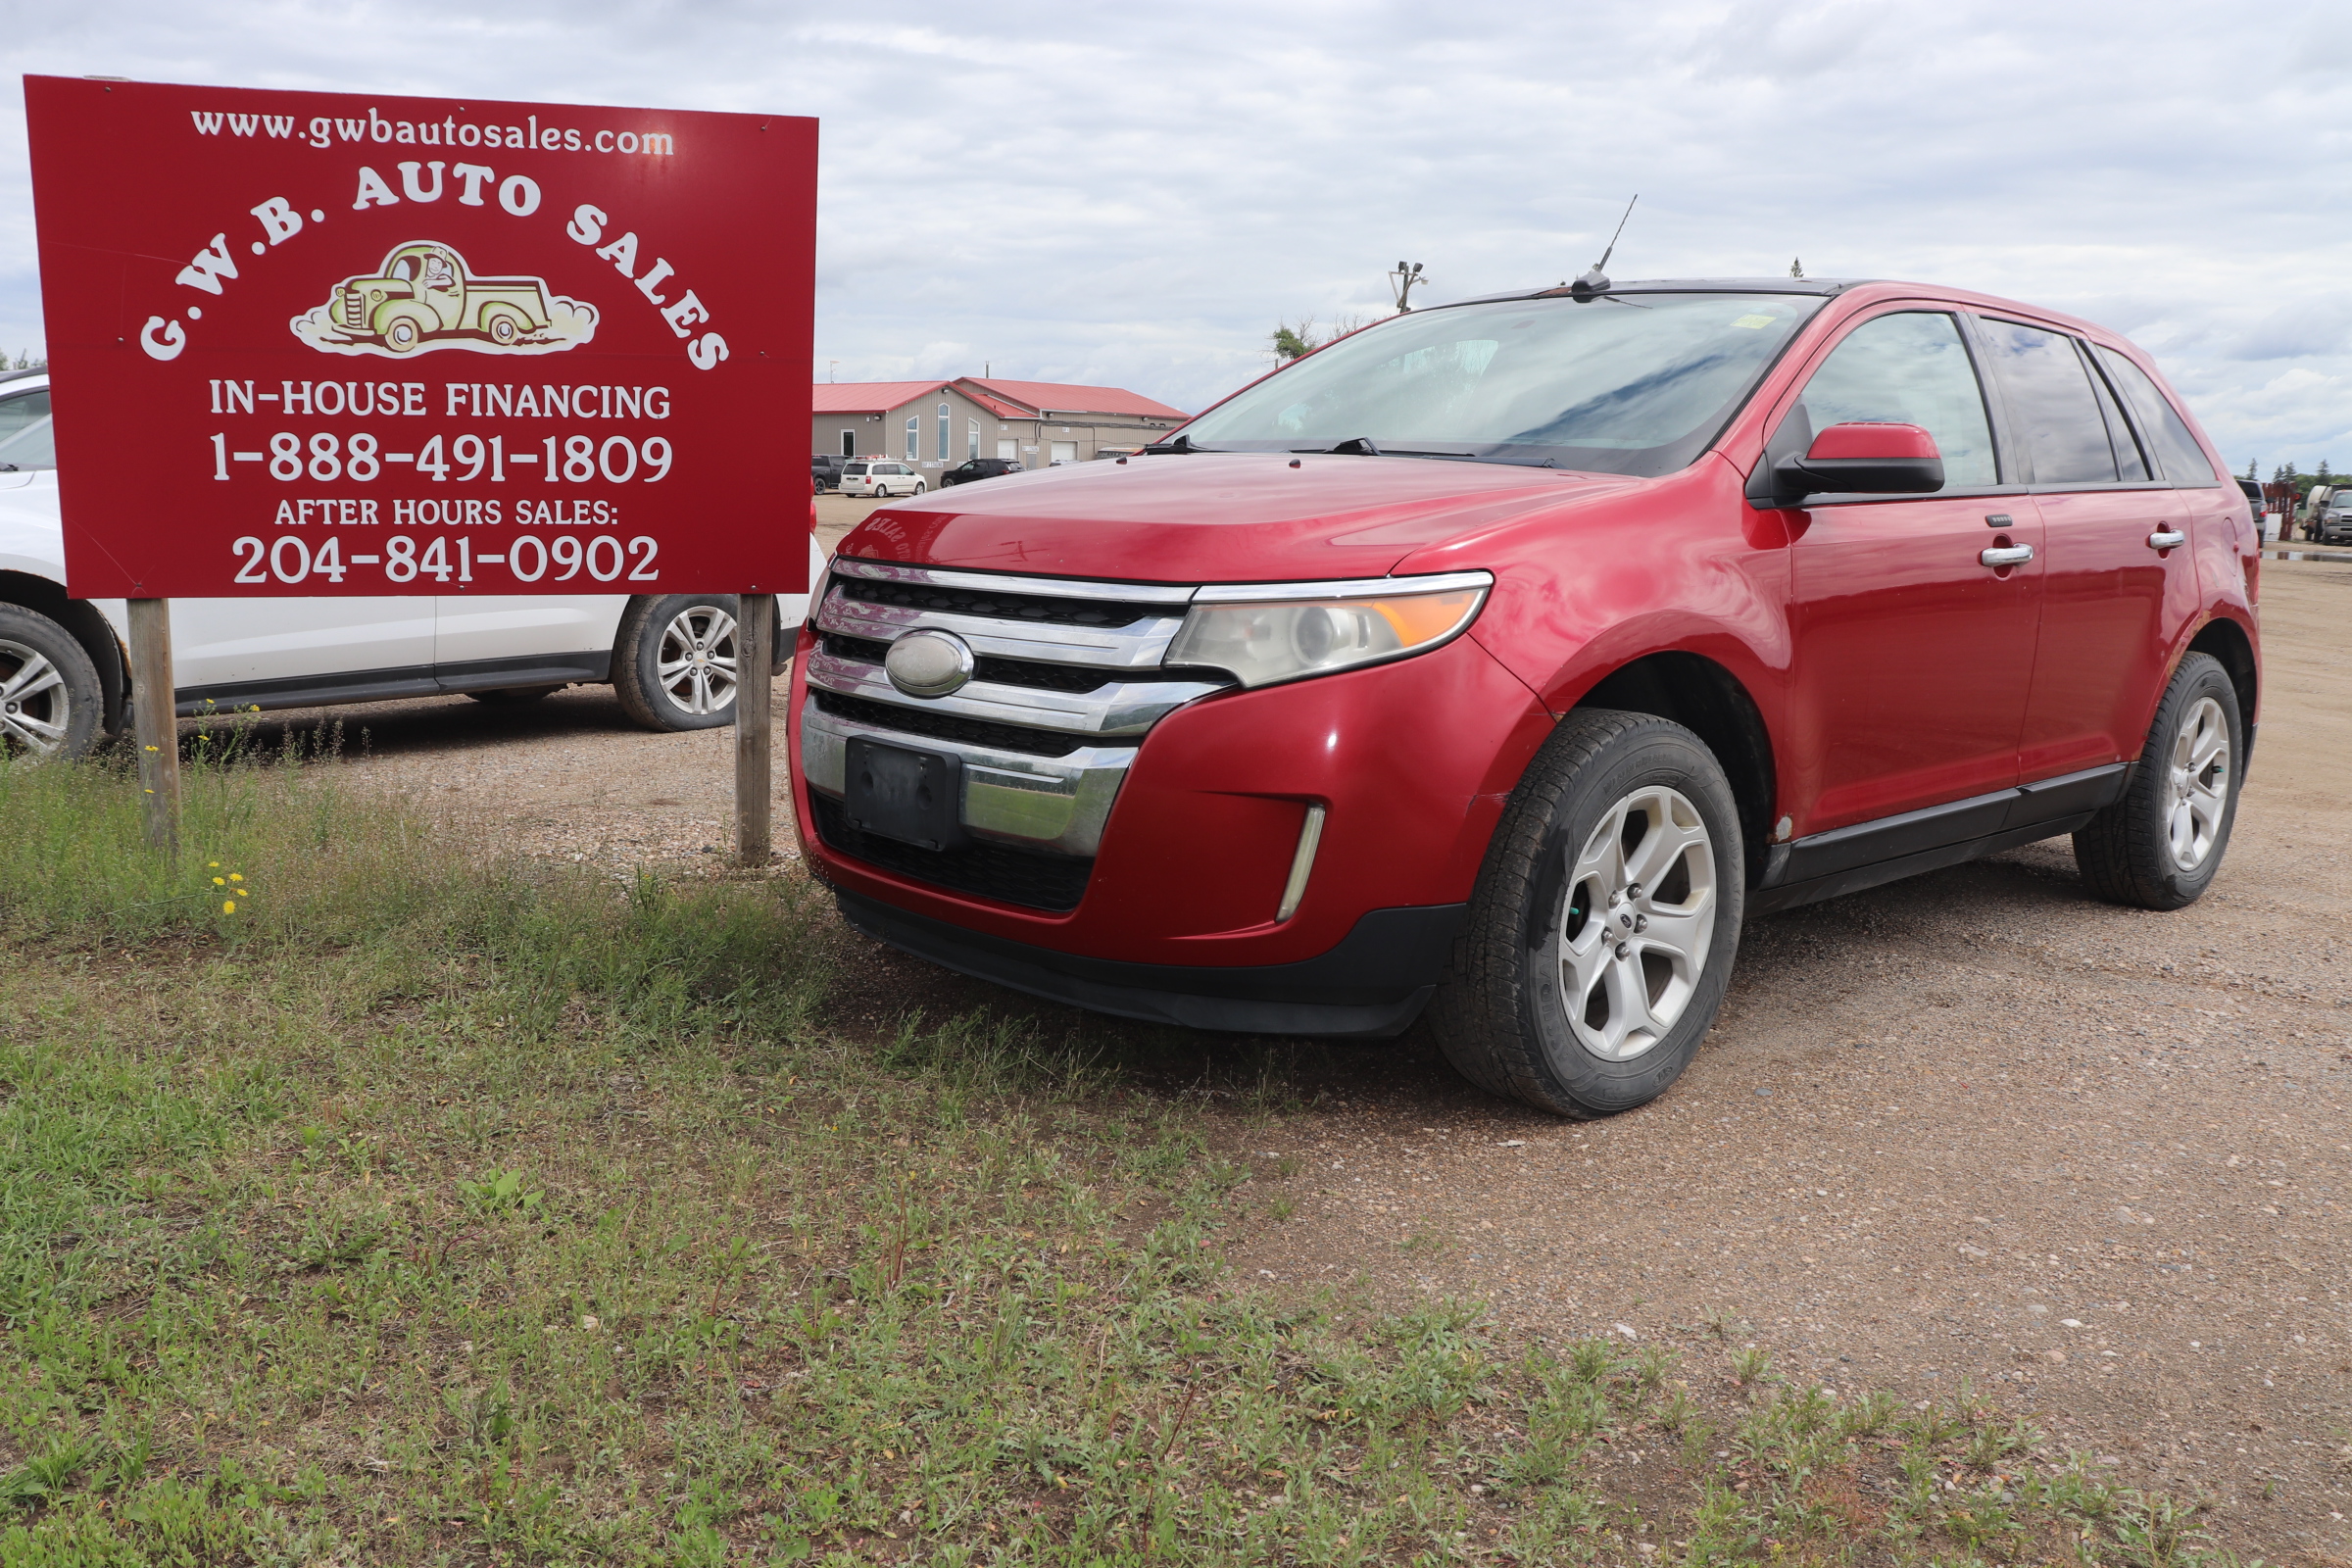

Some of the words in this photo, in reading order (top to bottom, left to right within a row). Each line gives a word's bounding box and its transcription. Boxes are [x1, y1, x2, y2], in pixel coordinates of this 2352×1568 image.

[190, 107, 675, 156] www.gwbautosales.com
[140, 196, 325, 362] G.W.B.
[352, 160, 542, 218] AUTO
[565, 203, 730, 370] SALES
[209, 379, 427, 416] IN-HOUSE
[445, 382, 671, 419] FINANCING
[210, 431, 674, 484] 1-888-491-1809
[273, 499, 379, 525] AFTER
[392, 499, 502, 525] HOURS
[514, 499, 618, 526] SALES:
[232, 536, 661, 585] 204-841-0902
